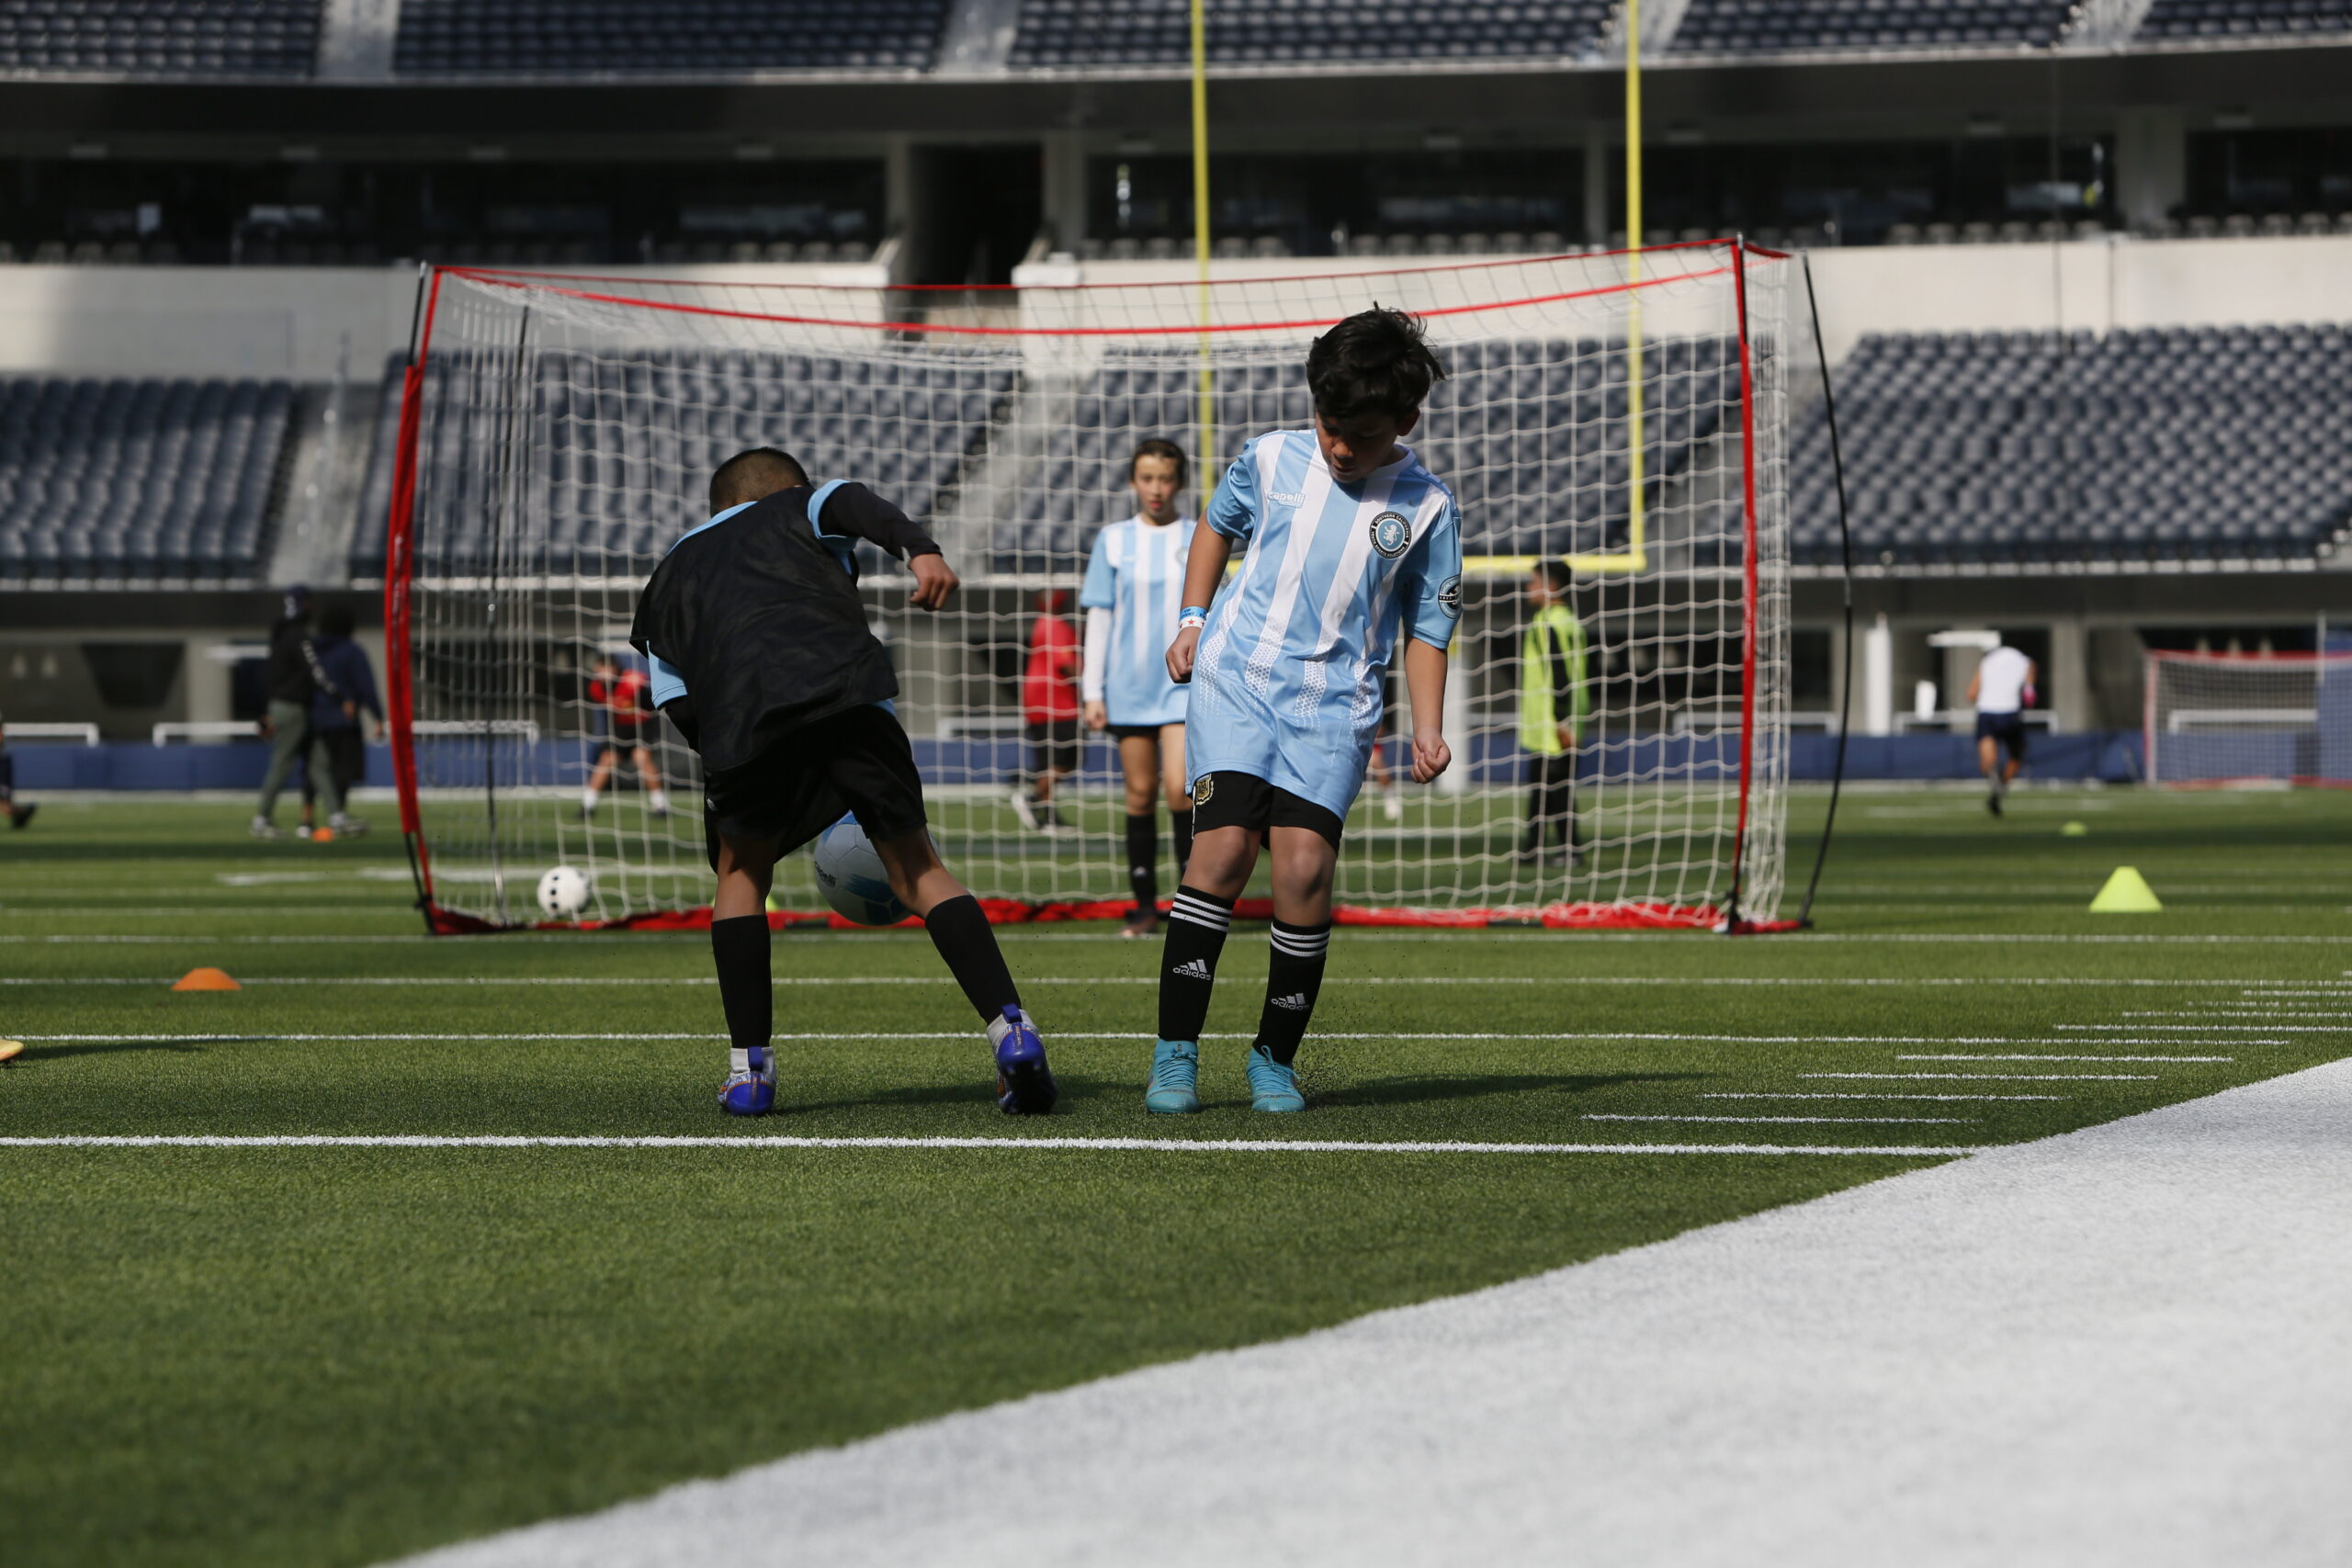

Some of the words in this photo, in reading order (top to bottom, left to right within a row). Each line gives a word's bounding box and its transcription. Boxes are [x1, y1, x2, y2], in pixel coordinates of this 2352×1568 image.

[1268, 492, 1305, 504] capelli
[1374, 513, 1396, 524] SOUTHERN
[1172, 965, 1212, 981] adidas
